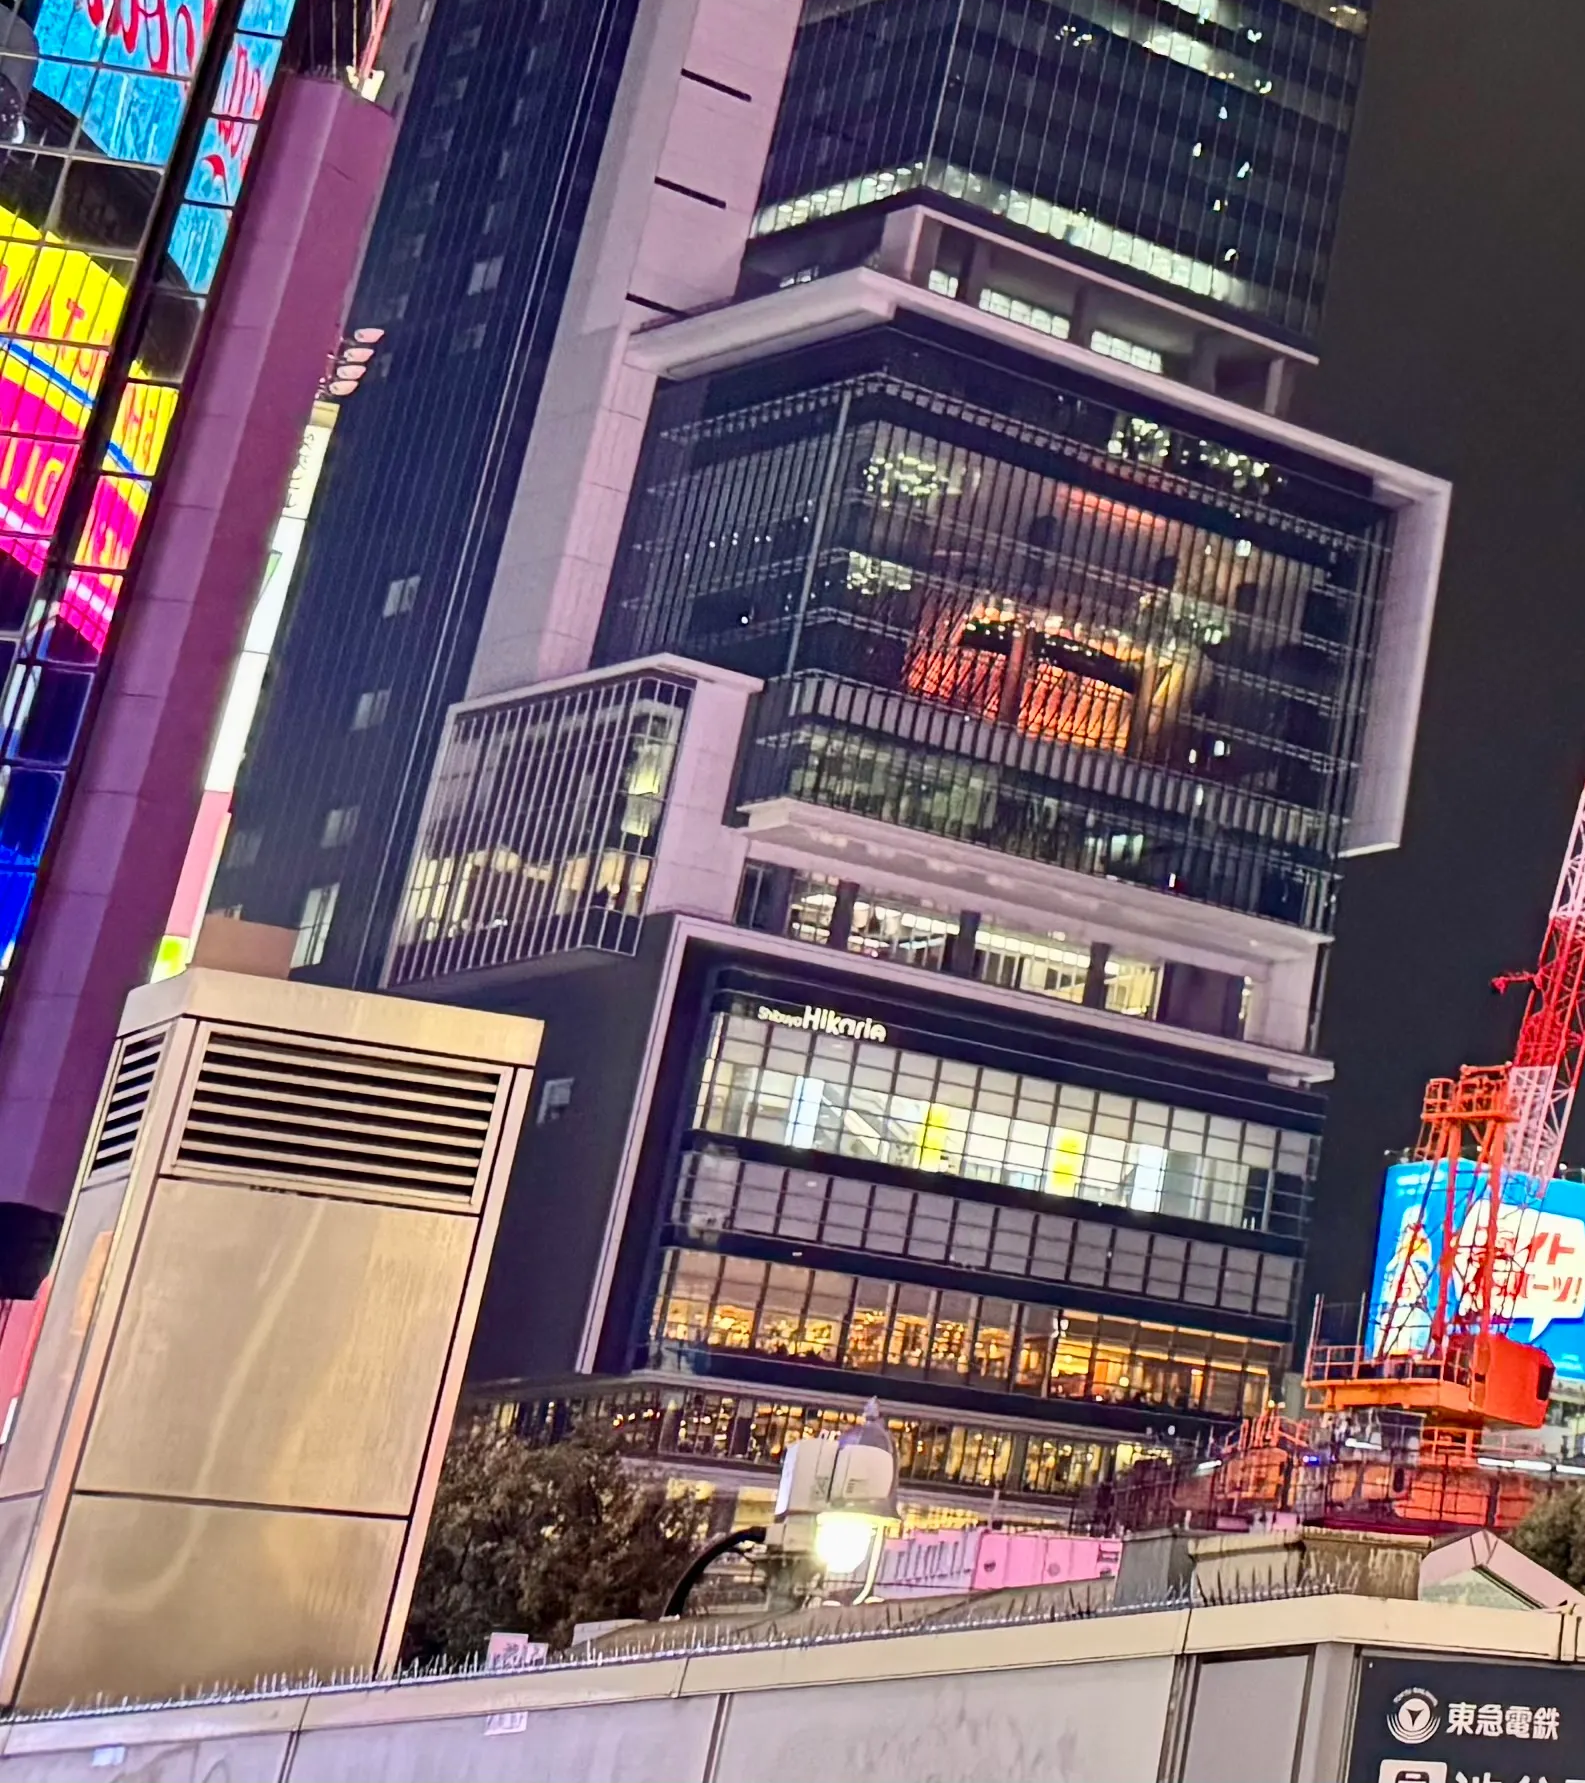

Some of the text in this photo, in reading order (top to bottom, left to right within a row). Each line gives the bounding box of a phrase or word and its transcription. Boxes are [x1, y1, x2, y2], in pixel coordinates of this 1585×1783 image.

[802, 1005, 887, 1042] Hikarie
[1446, 1702, 1560, 1741] 東急電鉄
